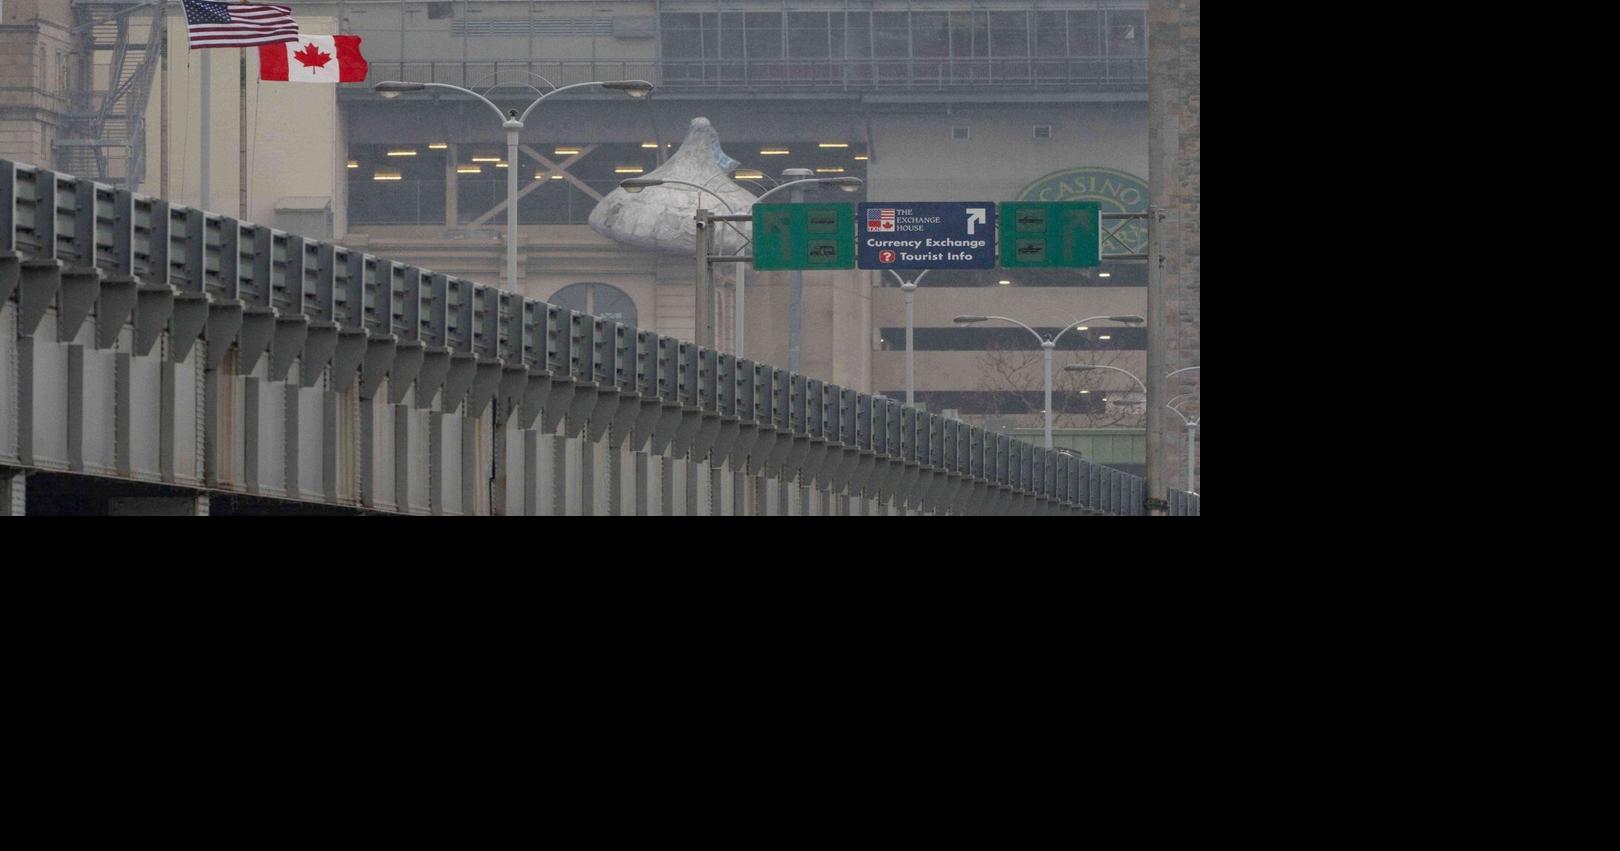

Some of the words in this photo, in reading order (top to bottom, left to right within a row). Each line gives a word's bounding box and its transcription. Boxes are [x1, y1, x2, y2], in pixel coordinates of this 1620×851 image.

[1040, 176, 1141, 205] CASINO
[897, 208, 913, 216] THE
[896, 216, 941, 224] EXCHANGE
[896, 224, 924, 232] HOUSE
[867, 238, 922, 249] Currency
[926, 238, 986, 249] Exchange
[900, 252, 944, 261] Tourist
[948, 251, 973, 261] Info
